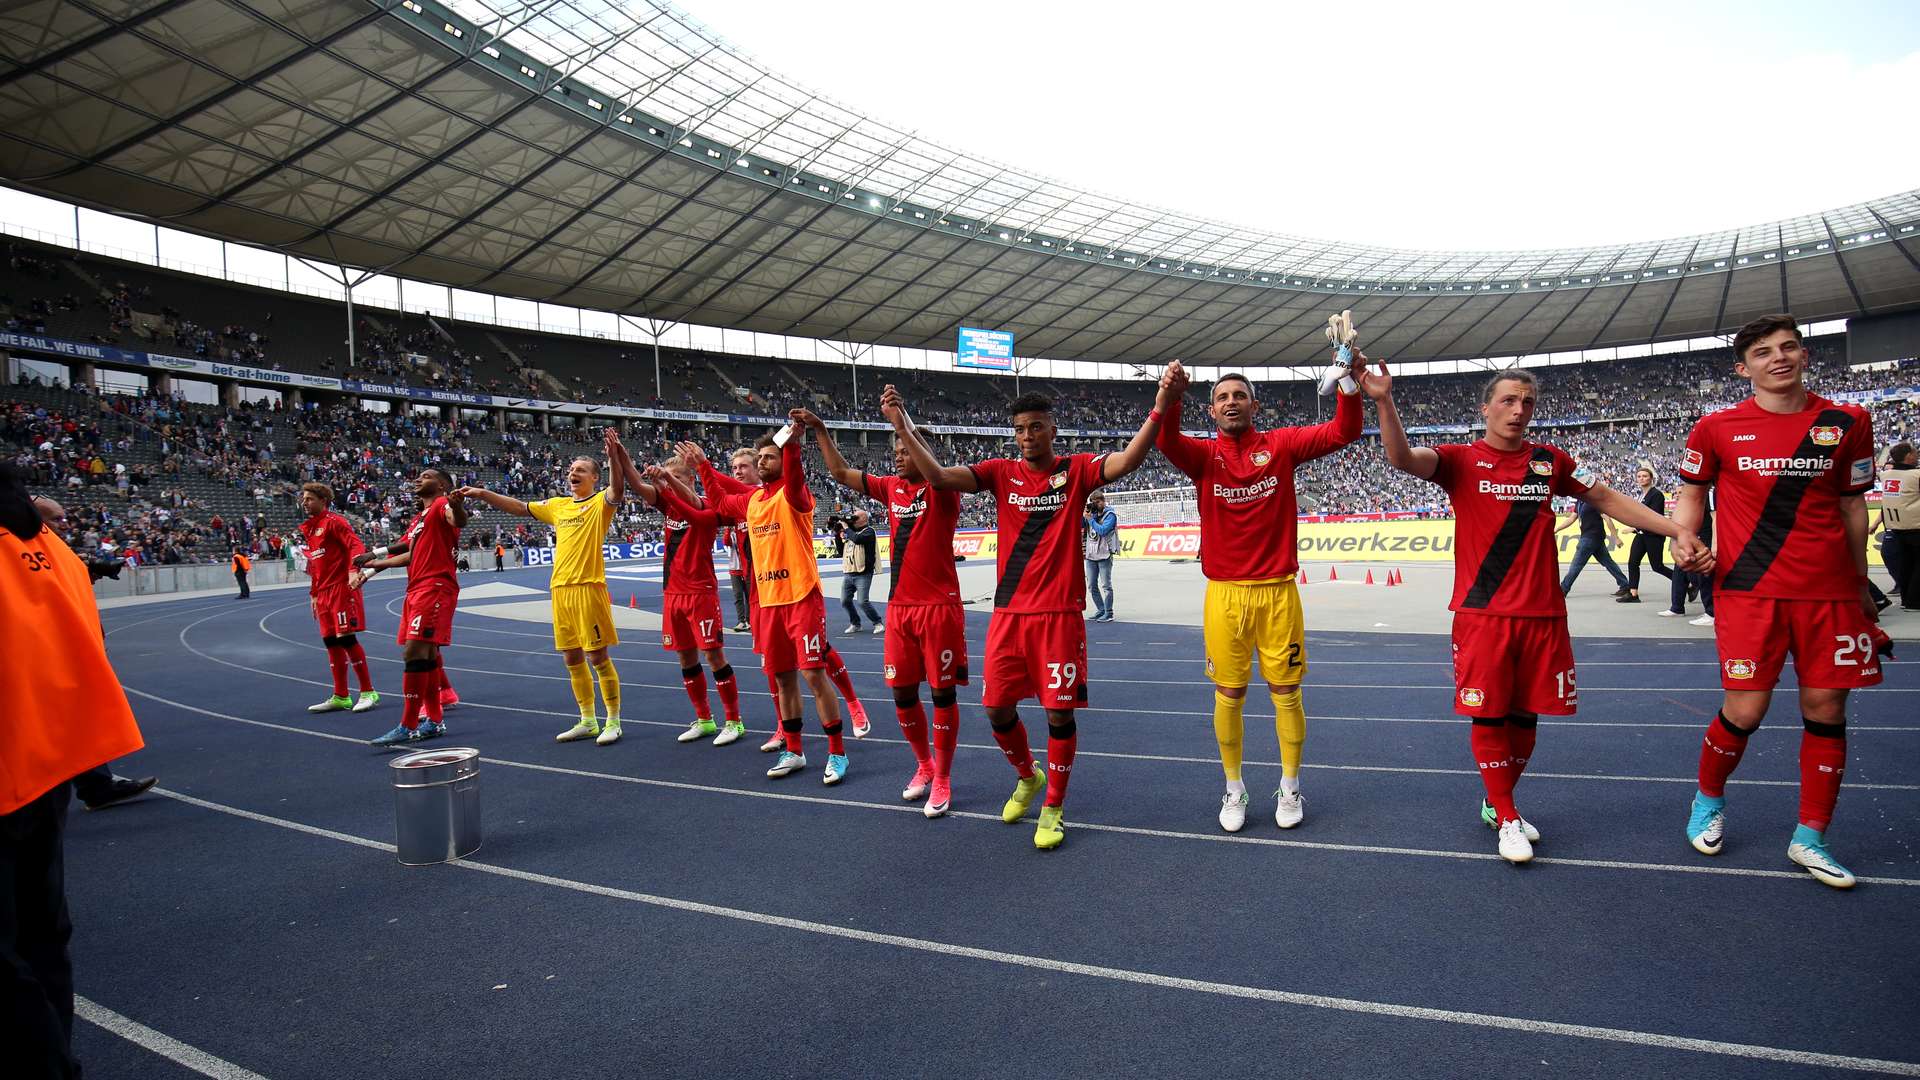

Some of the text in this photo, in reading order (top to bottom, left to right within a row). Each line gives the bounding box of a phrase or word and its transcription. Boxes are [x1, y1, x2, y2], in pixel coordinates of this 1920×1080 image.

[54, 341, 75, 354] WE
[212, 364, 291, 383] bet-at-home
[361, 383, 410, 396] HERTHA BSC
[431, 391, 476, 402] HERTHA BSC
[653, 410, 698, 420] bet-at-home
[1732, 434, 1756, 442] JAKO
[1476, 460, 1493, 469] JAKO
[1737, 455, 1834, 471] Barmenia
[1758, 469, 1825, 478] Versicherungen
[1213, 475, 1279, 498] Barmenia
[1479, 480, 1550, 494] Barmenia
[1008, 492, 1067, 506] Barmenia
[1495, 494, 1548, 502] Versicherungen
[1019, 504, 1064, 512] Versicherungen
[1887, 507, 1900, 522] 11
[1147, 533, 1201, 552] RYOBI
[21, 551, 52, 572] 35
[337, 611, 347, 625] 11
[410, 614, 423, 630] 4
[593, 624, 601, 639] 1
[699, 619, 714, 637] 17
[802, 634, 821, 654] 14
[1834, 632, 1873, 666] 29
[940, 649, 953, 671] 9
[1047, 662, 1077, 689] 39
